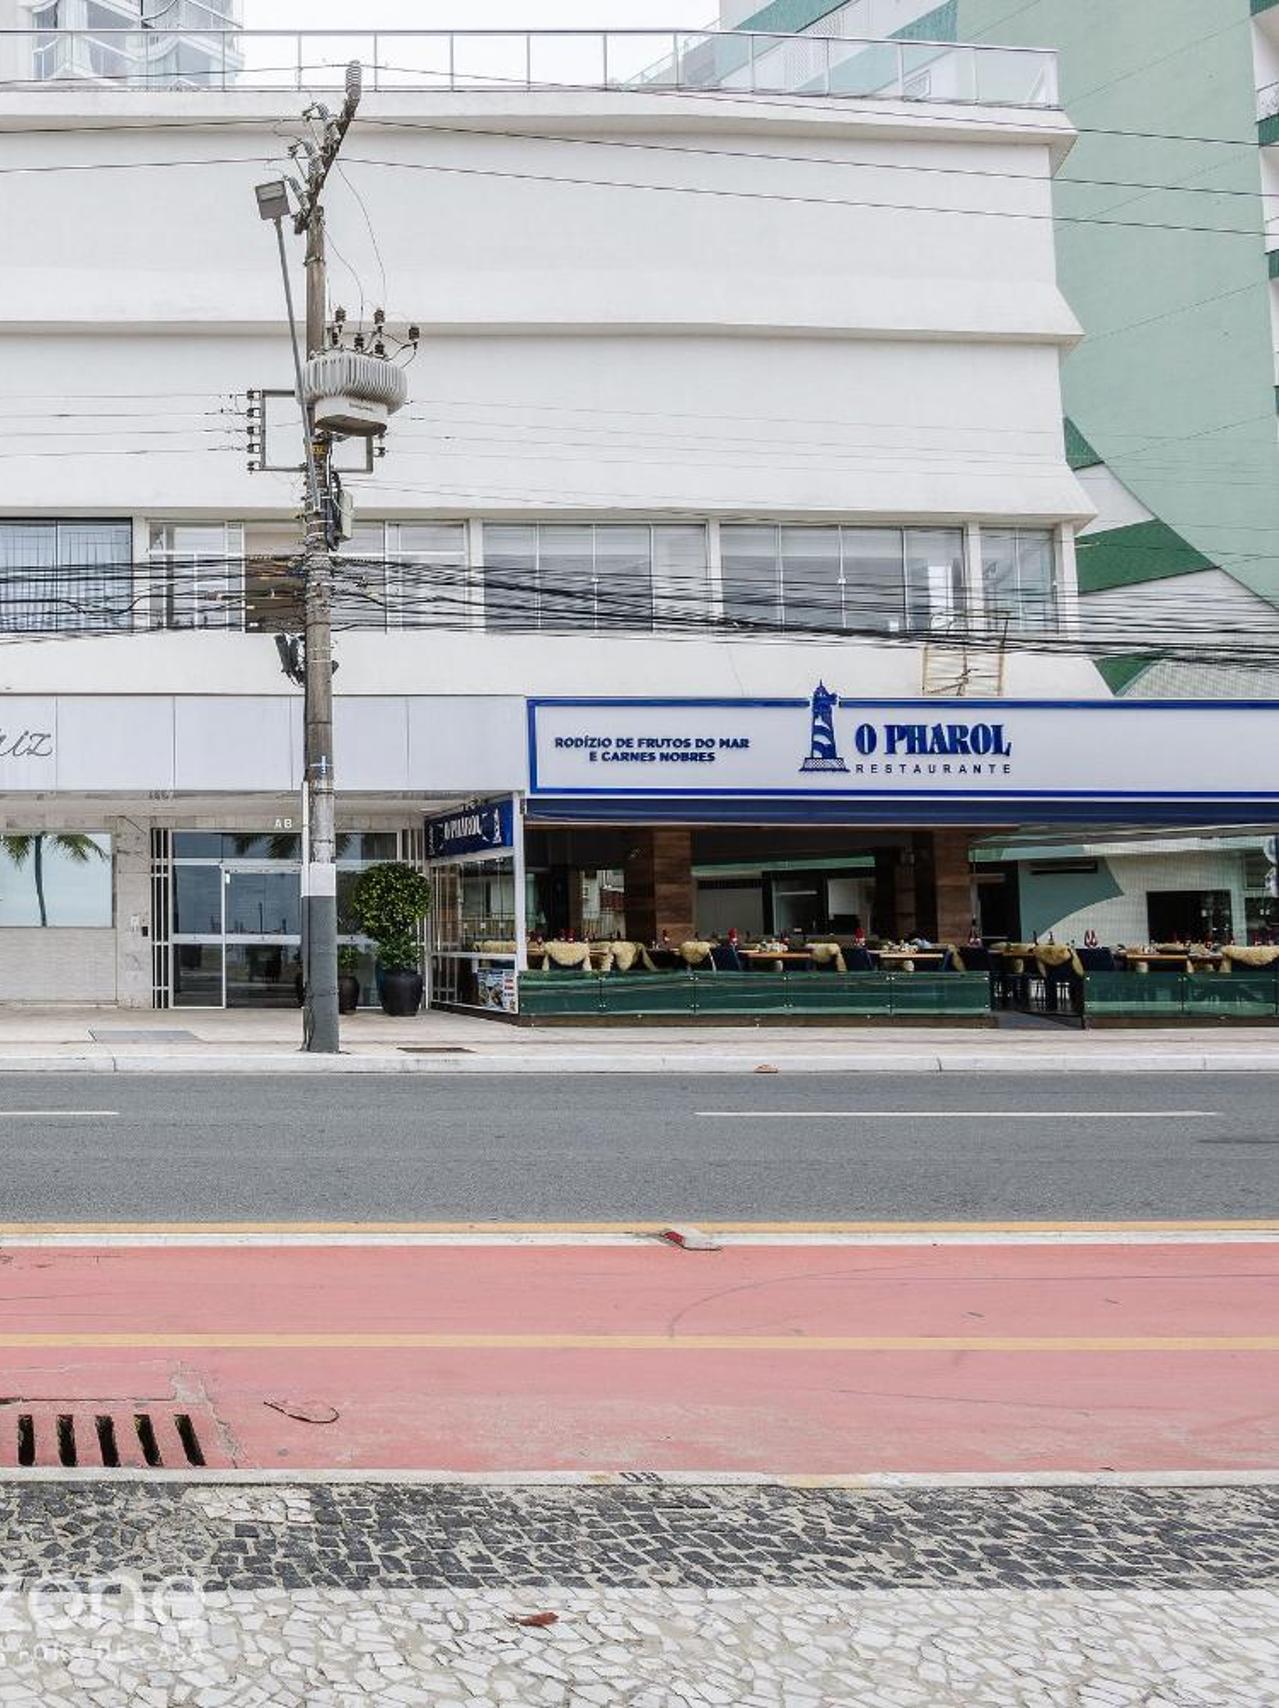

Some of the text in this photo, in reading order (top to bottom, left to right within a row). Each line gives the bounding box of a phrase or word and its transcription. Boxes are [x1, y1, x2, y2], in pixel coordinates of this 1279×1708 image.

[554, 735, 750, 749] RODÍZIO DE FRUTOS DO MAR
[854, 723, 1012, 757] O PHAROL
[589, 752, 716, 762] E CARNES NOBRES
[855, 764, 1011, 774] RESTAURANTE
[274, 818, 293, 830] AB
